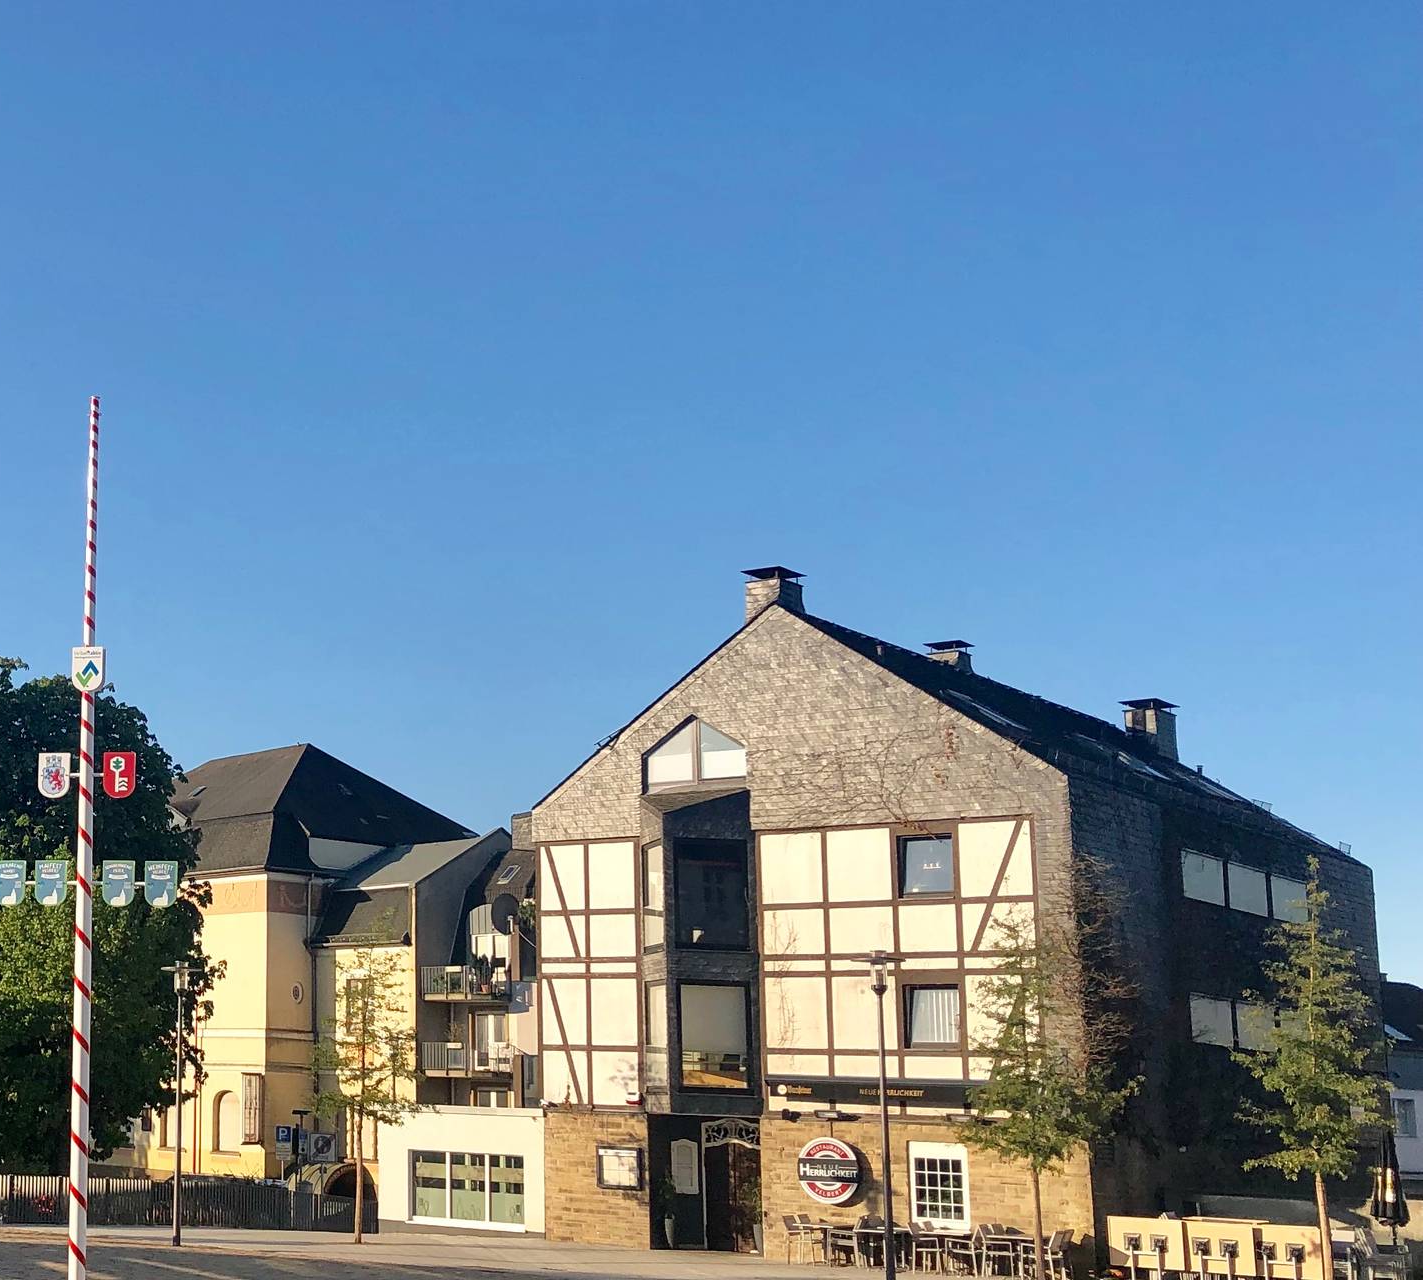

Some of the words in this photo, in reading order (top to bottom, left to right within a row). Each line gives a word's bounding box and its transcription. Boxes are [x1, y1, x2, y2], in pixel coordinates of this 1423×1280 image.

[877, 1088, 925, 1097] HRRLICHKEIT
[279, 1127, 288, 1140] P
[809, 1144, 845, 1156] RESTAURANT
[815, 1188, 843, 1197] VELBERT
